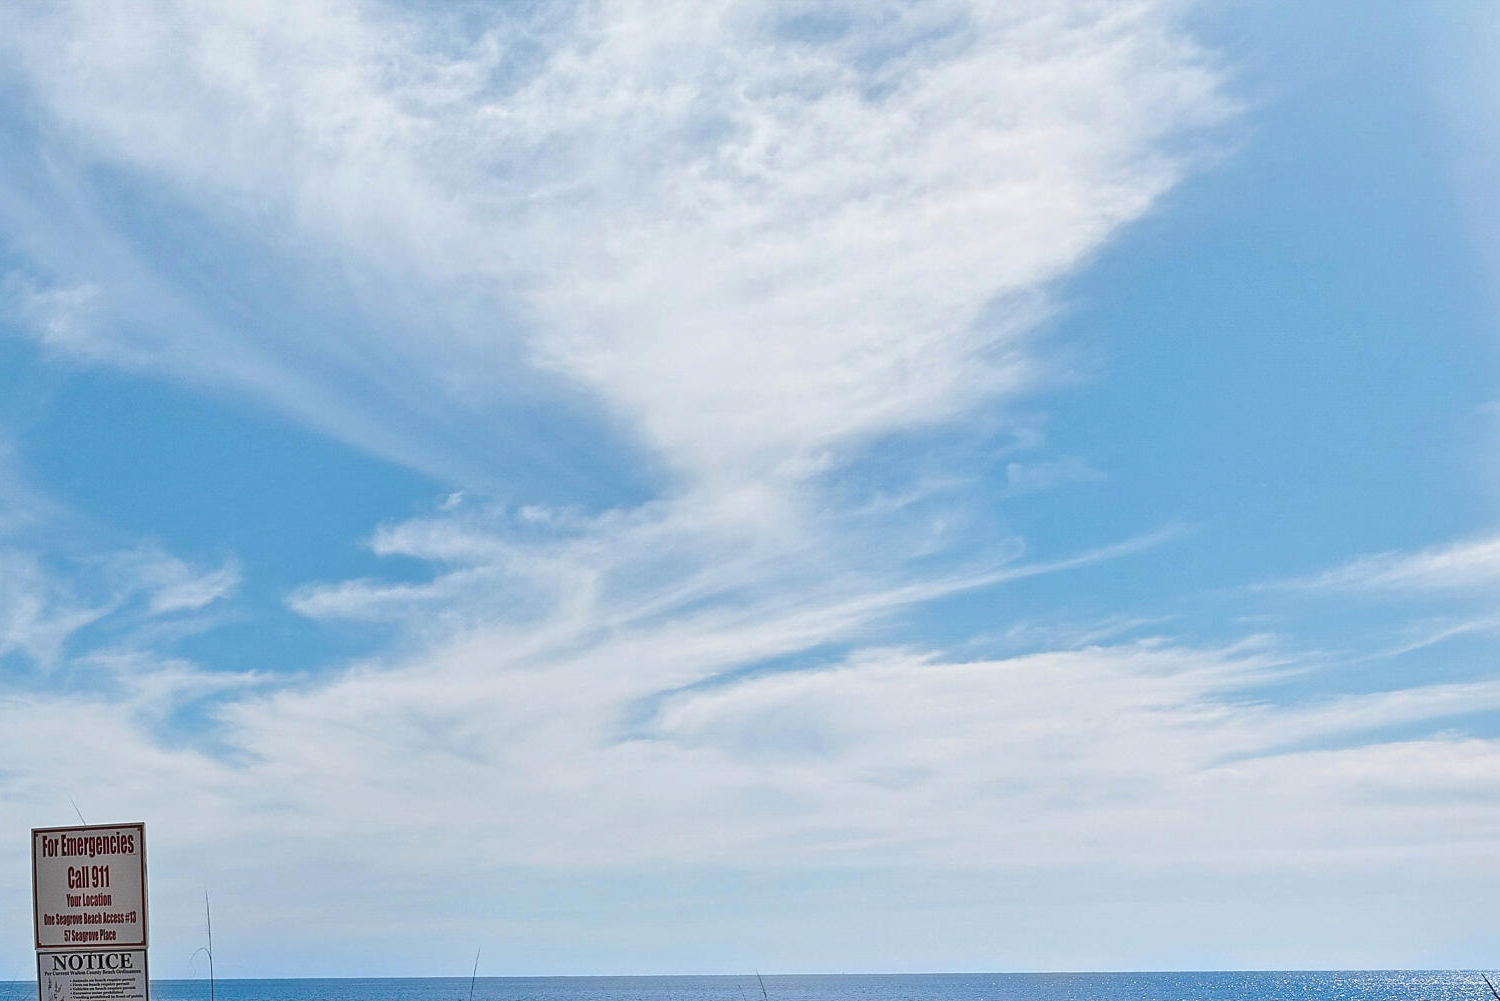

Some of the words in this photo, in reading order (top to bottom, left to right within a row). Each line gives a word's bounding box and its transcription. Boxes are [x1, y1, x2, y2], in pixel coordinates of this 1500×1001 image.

[42, 836, 59, 858] For
[61, 832, 135, 858] Emergencies
[67, 866, 90, 889] Call
[91, 865, 110, 888] 911
[66, 893, 82, 907] Your
[83, 892, 112, 907] Location
[44, 914, 55, 926] One
[56, 913, 83, 926] Seagrove
[84, 912, 103, 925] Beach
[103, 912, 124, 924] Access
[125, 911, 137, 923] #13
[72, 929, 99, 943] Seagrove
[100, 929, 116, 941] Place
[52, 953, 133, 971] NOTICE
